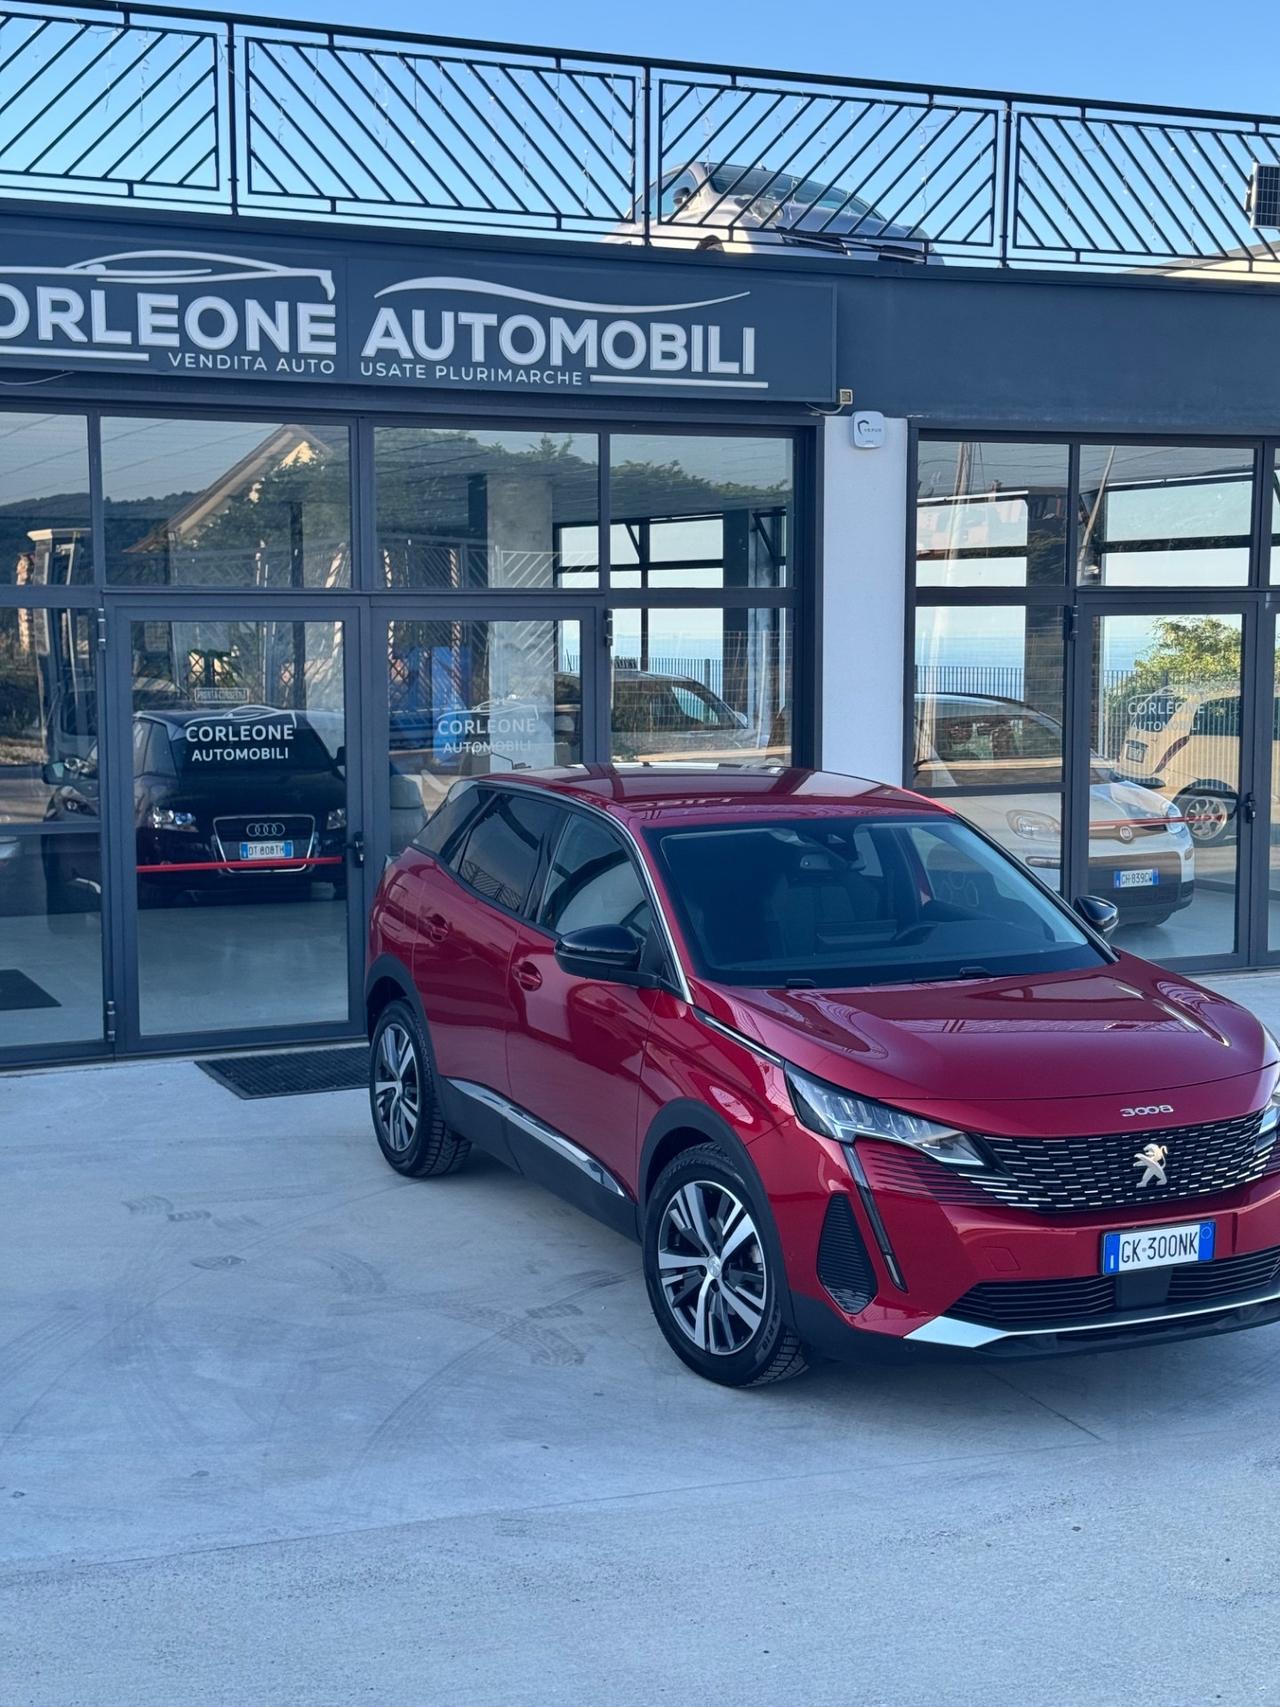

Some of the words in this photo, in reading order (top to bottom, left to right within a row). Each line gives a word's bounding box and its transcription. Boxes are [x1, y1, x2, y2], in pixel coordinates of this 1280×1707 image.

[360, 306, 755, 375] AUTOMOBILI
[168, 352, 267, 371] VENDITA
[276, 357, 335, 374] AUTO
[360, 361, 427, 379] USATE
[436, 365, 583, 386] PLURIMARCHE
[185, 724, 294, 742] CORLEONE
[438, 718, 536, 735] CORLEONE
[191, 747, 289, 762] AUTOMOBILI
[443, 739, 531, 754] AUTOMOBILI
[1119, 1104, 1174, 1117] 3008
